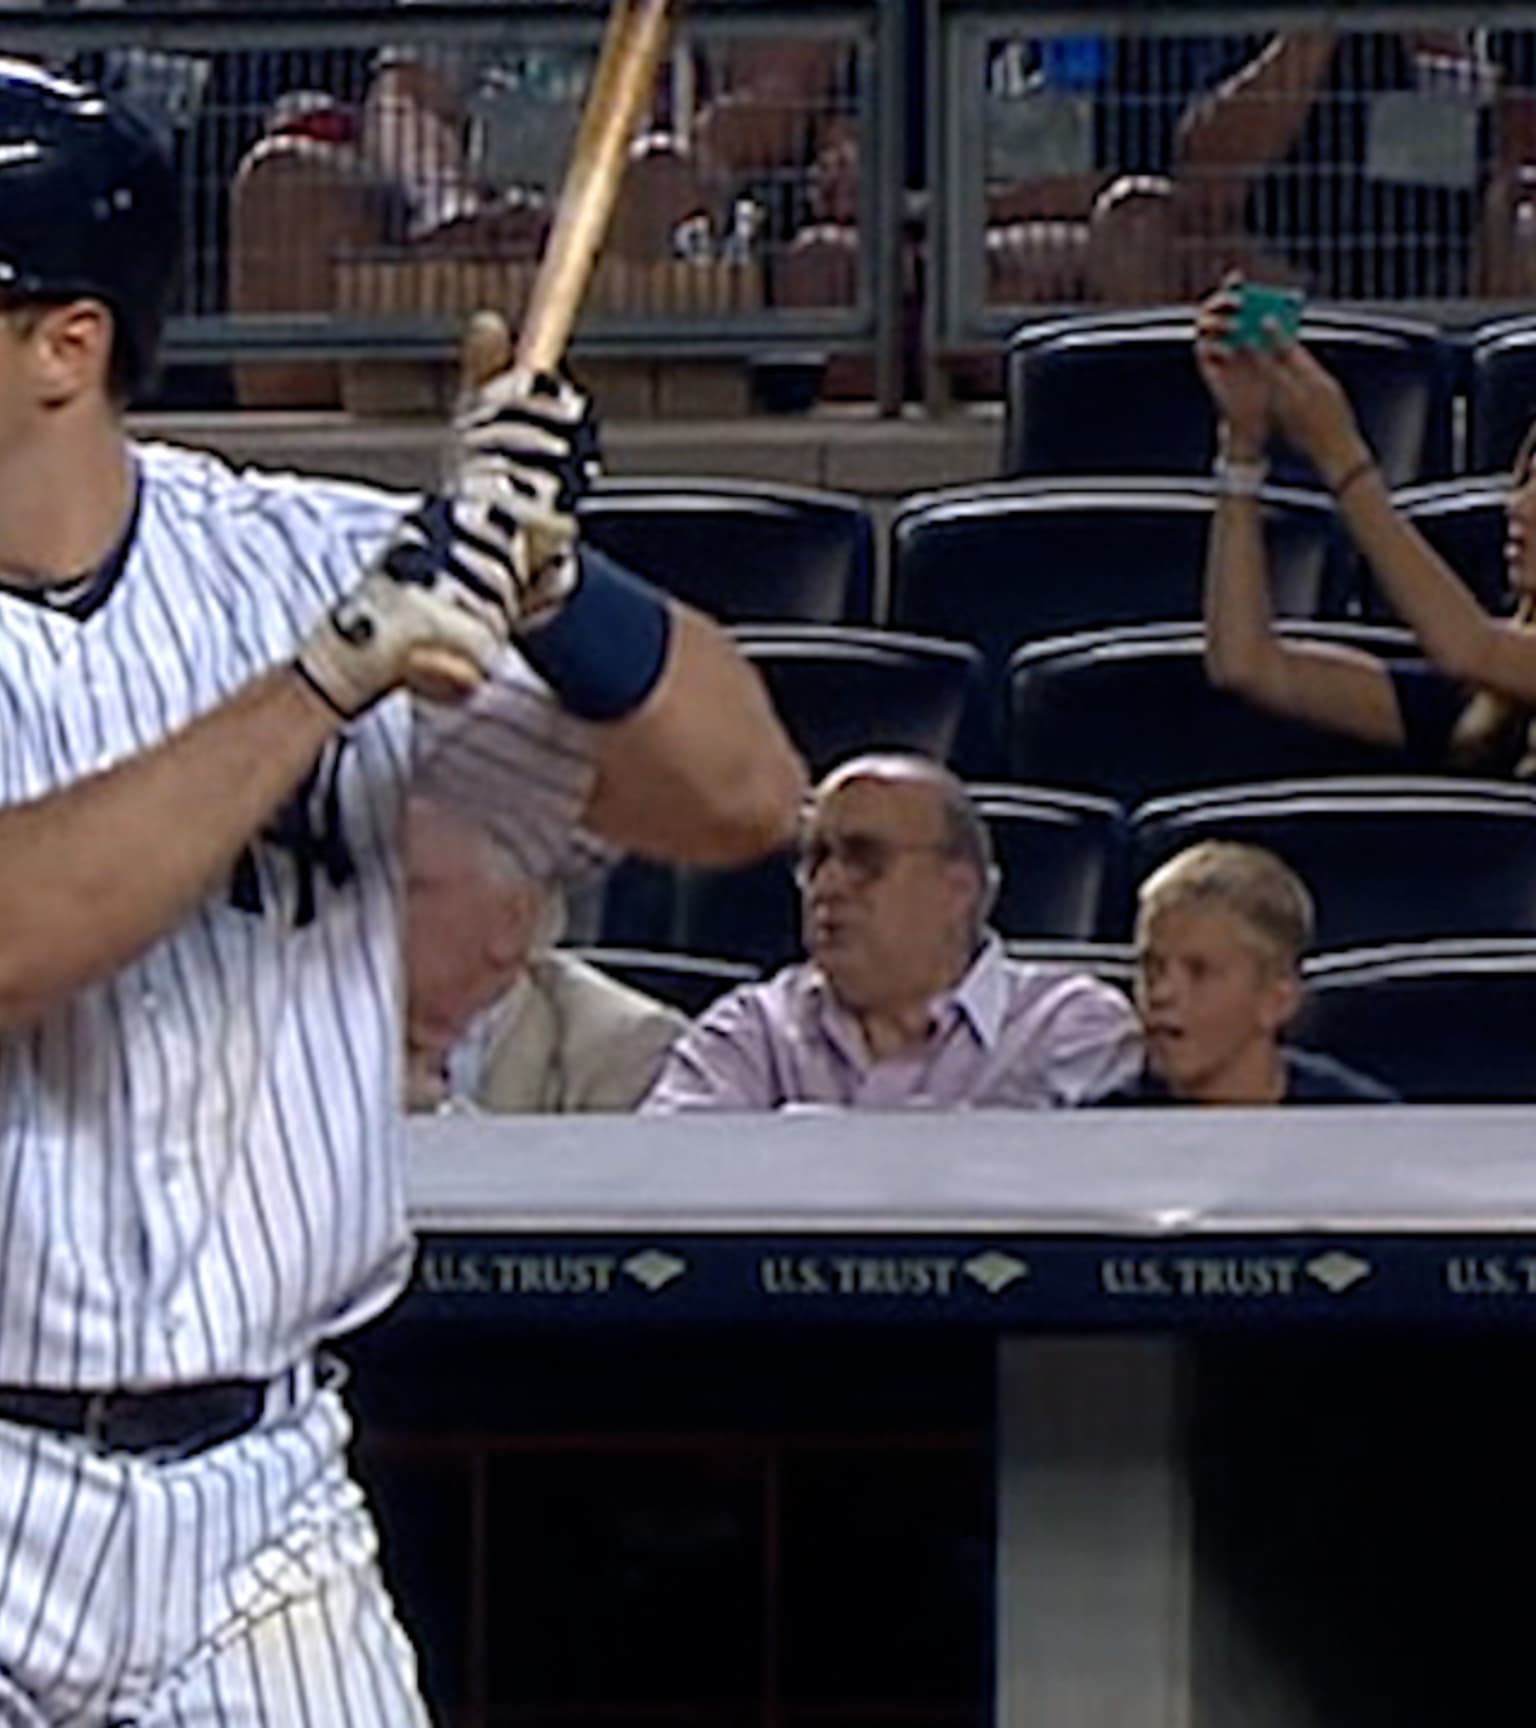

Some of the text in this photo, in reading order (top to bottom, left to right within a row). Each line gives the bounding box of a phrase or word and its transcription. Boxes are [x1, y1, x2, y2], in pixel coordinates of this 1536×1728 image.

[422, 1255, 614, 1293] U.S. TRUST
[761, 1256, 957, 1294] U.S. TRUST
[1101, 1257, 1298, 1294] U.S. TRUST
[1446, 1257, 1517, 1294] U.S.
